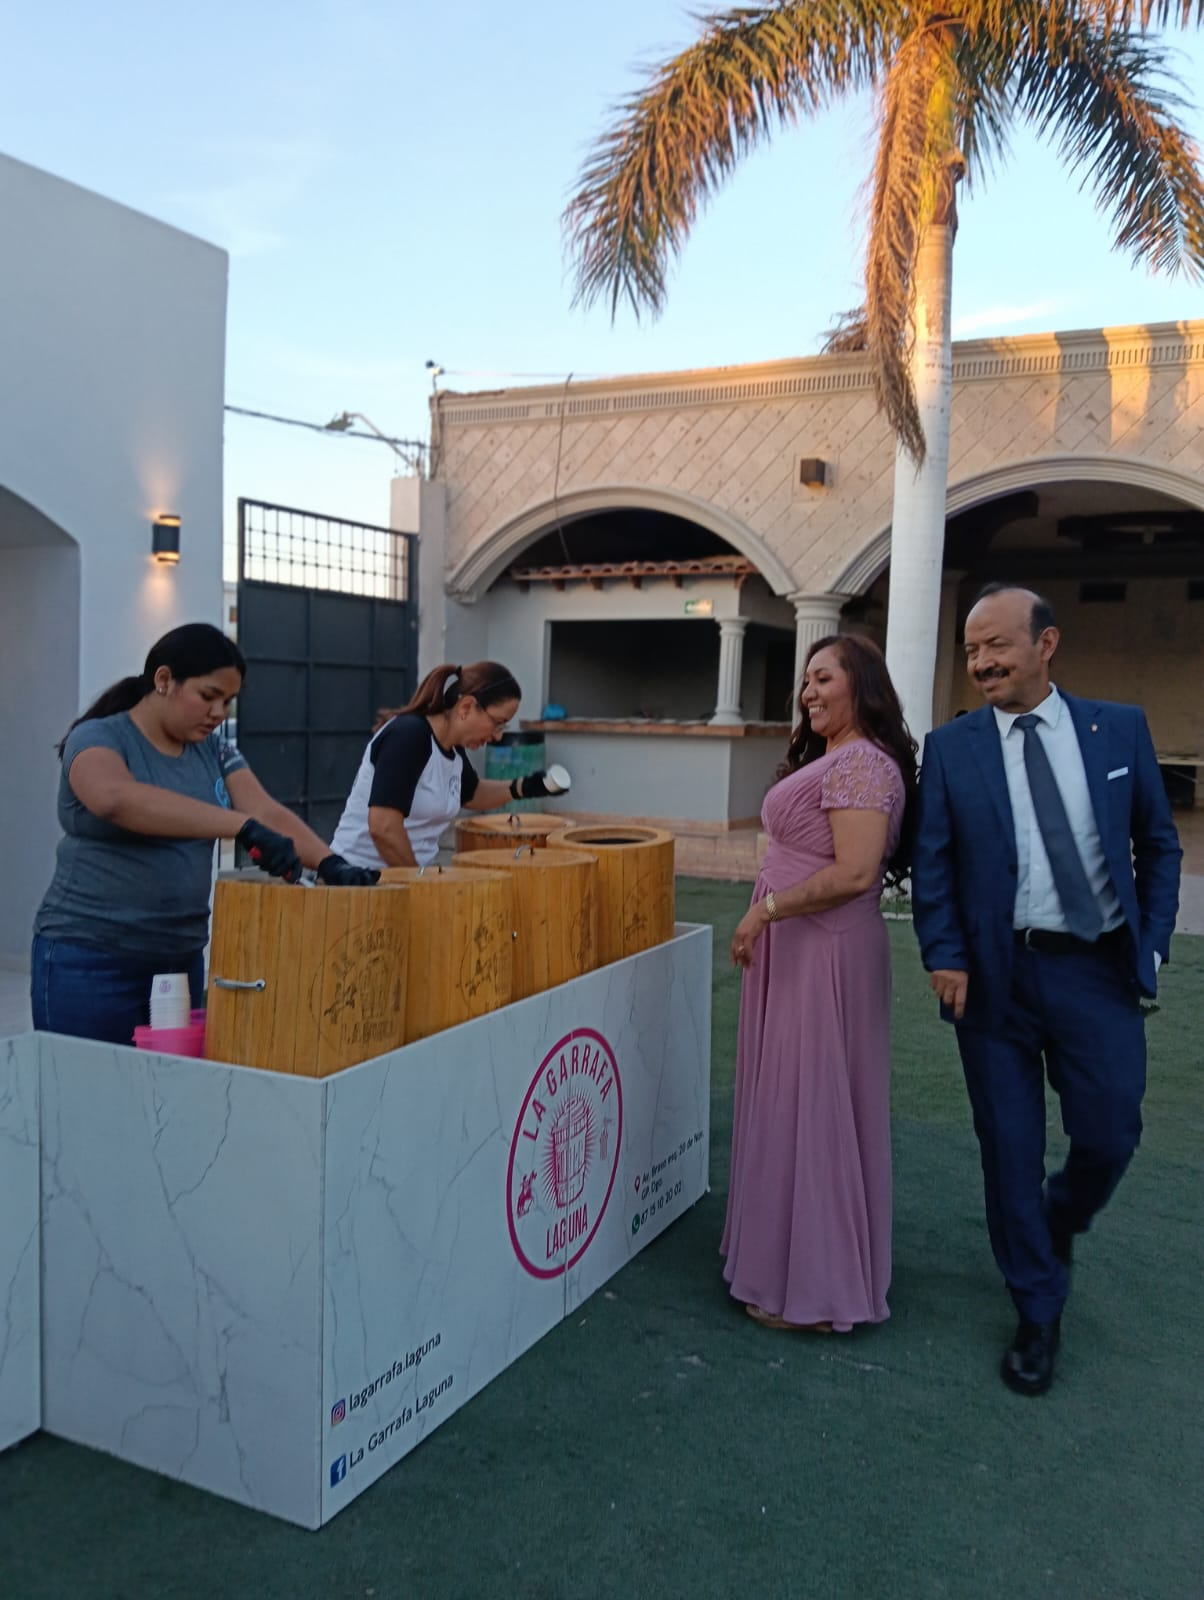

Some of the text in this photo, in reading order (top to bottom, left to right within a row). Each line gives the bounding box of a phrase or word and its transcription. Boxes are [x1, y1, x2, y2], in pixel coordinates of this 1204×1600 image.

[523, 1043, 613, 1142] LA GARRAFA
[546, 1202, 588, 1260] LAGUNA
[350, 1332, 441, 1413] lagarrafa.laguna
[350, 1446, 364, 1468] La
[368, 1407, 412, 1451] Garrafa
[416, 1374, 453, 1414] Laguna
